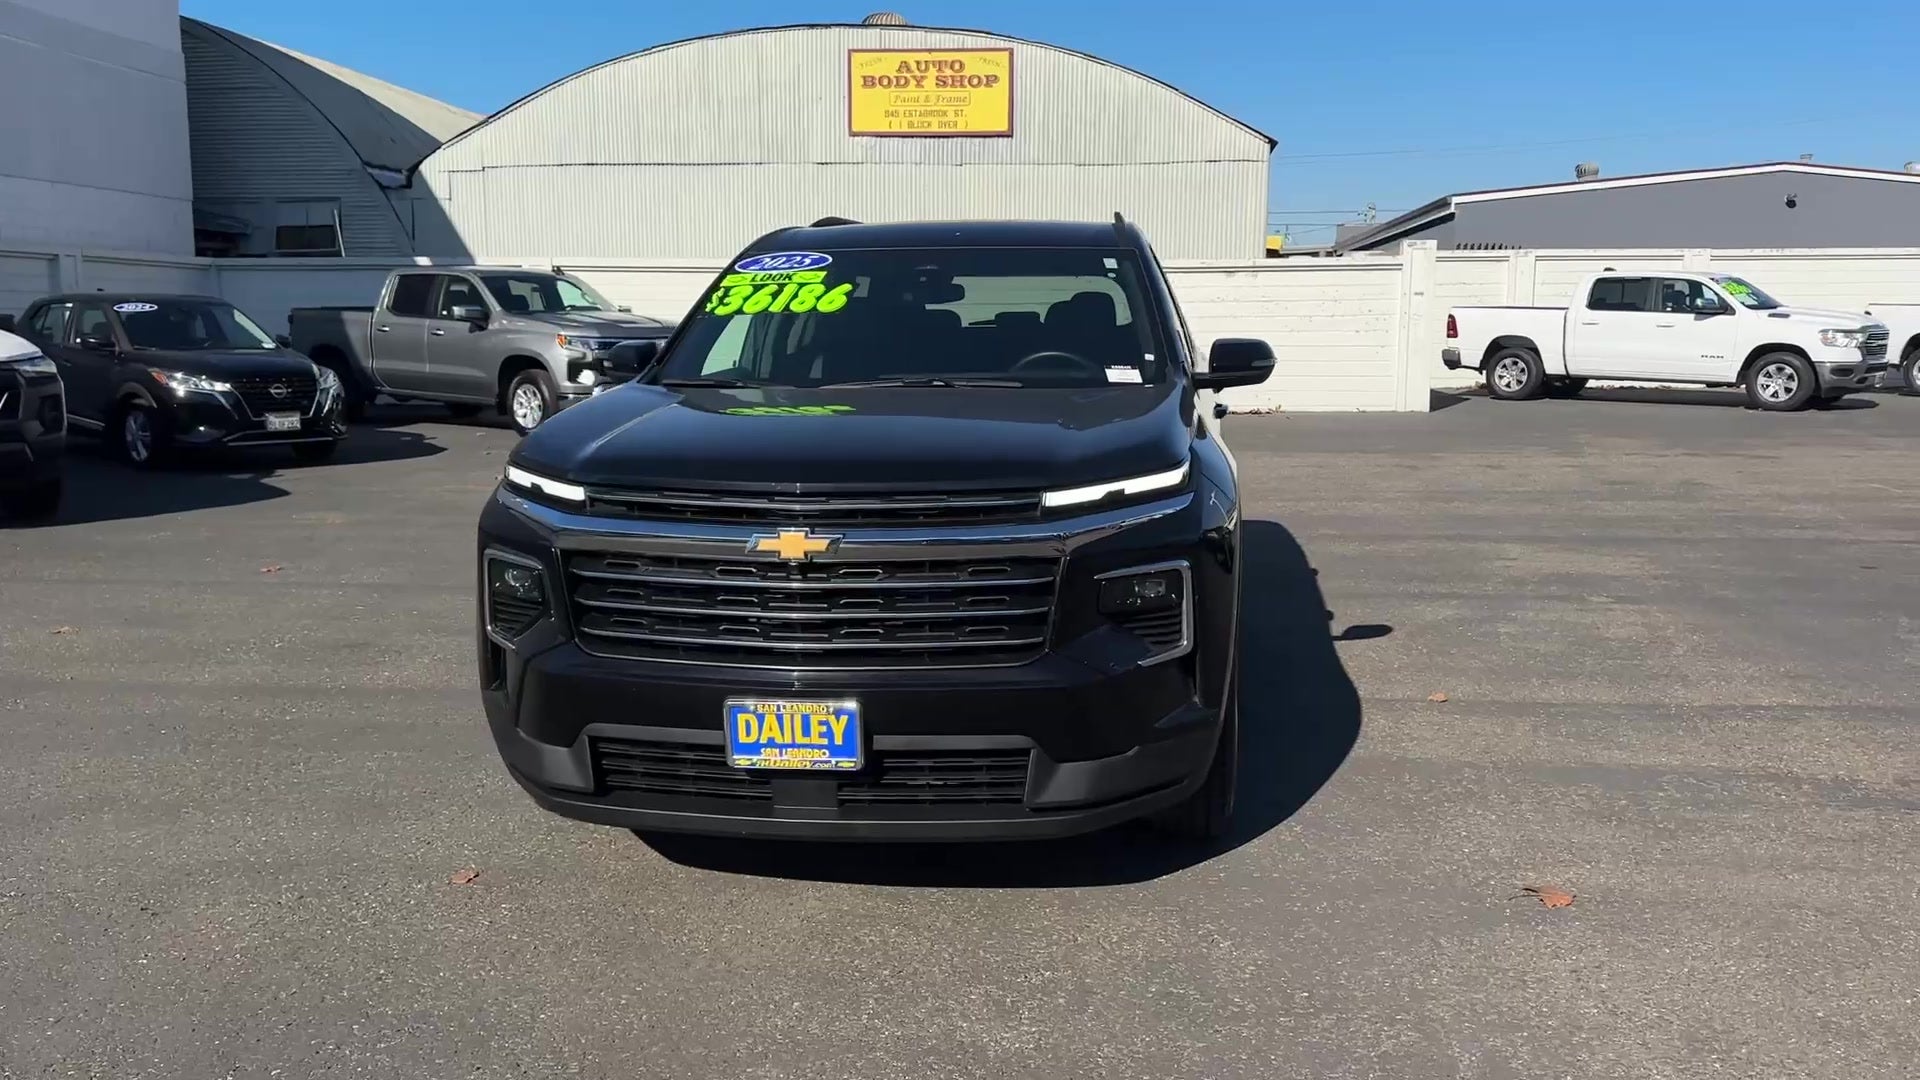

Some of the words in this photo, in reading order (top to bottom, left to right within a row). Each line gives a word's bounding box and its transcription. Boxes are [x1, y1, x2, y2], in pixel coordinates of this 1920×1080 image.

[896, 59, 966, 74] AUTO
[861, 75, 928, 89] BODY
[935, 74, 1001, 88] SHOP
[894, 94, 920, 104] Paint
[923, 94, 931, 104] &
[934, 94, 968, 106] Frame
[750, 254, 820, 270] 2025
[751, 272, 795, 283] LOOK
[705, 283, 854, 316] $36186
[756, 703, 777, 713] SAN
[780, 703, 828, 714] LEANDRO
[736, 713, 849, 745] DAILEY
[760, 747, 780, 758] SAN
[782, 748, 830, 759] LEANDRO
